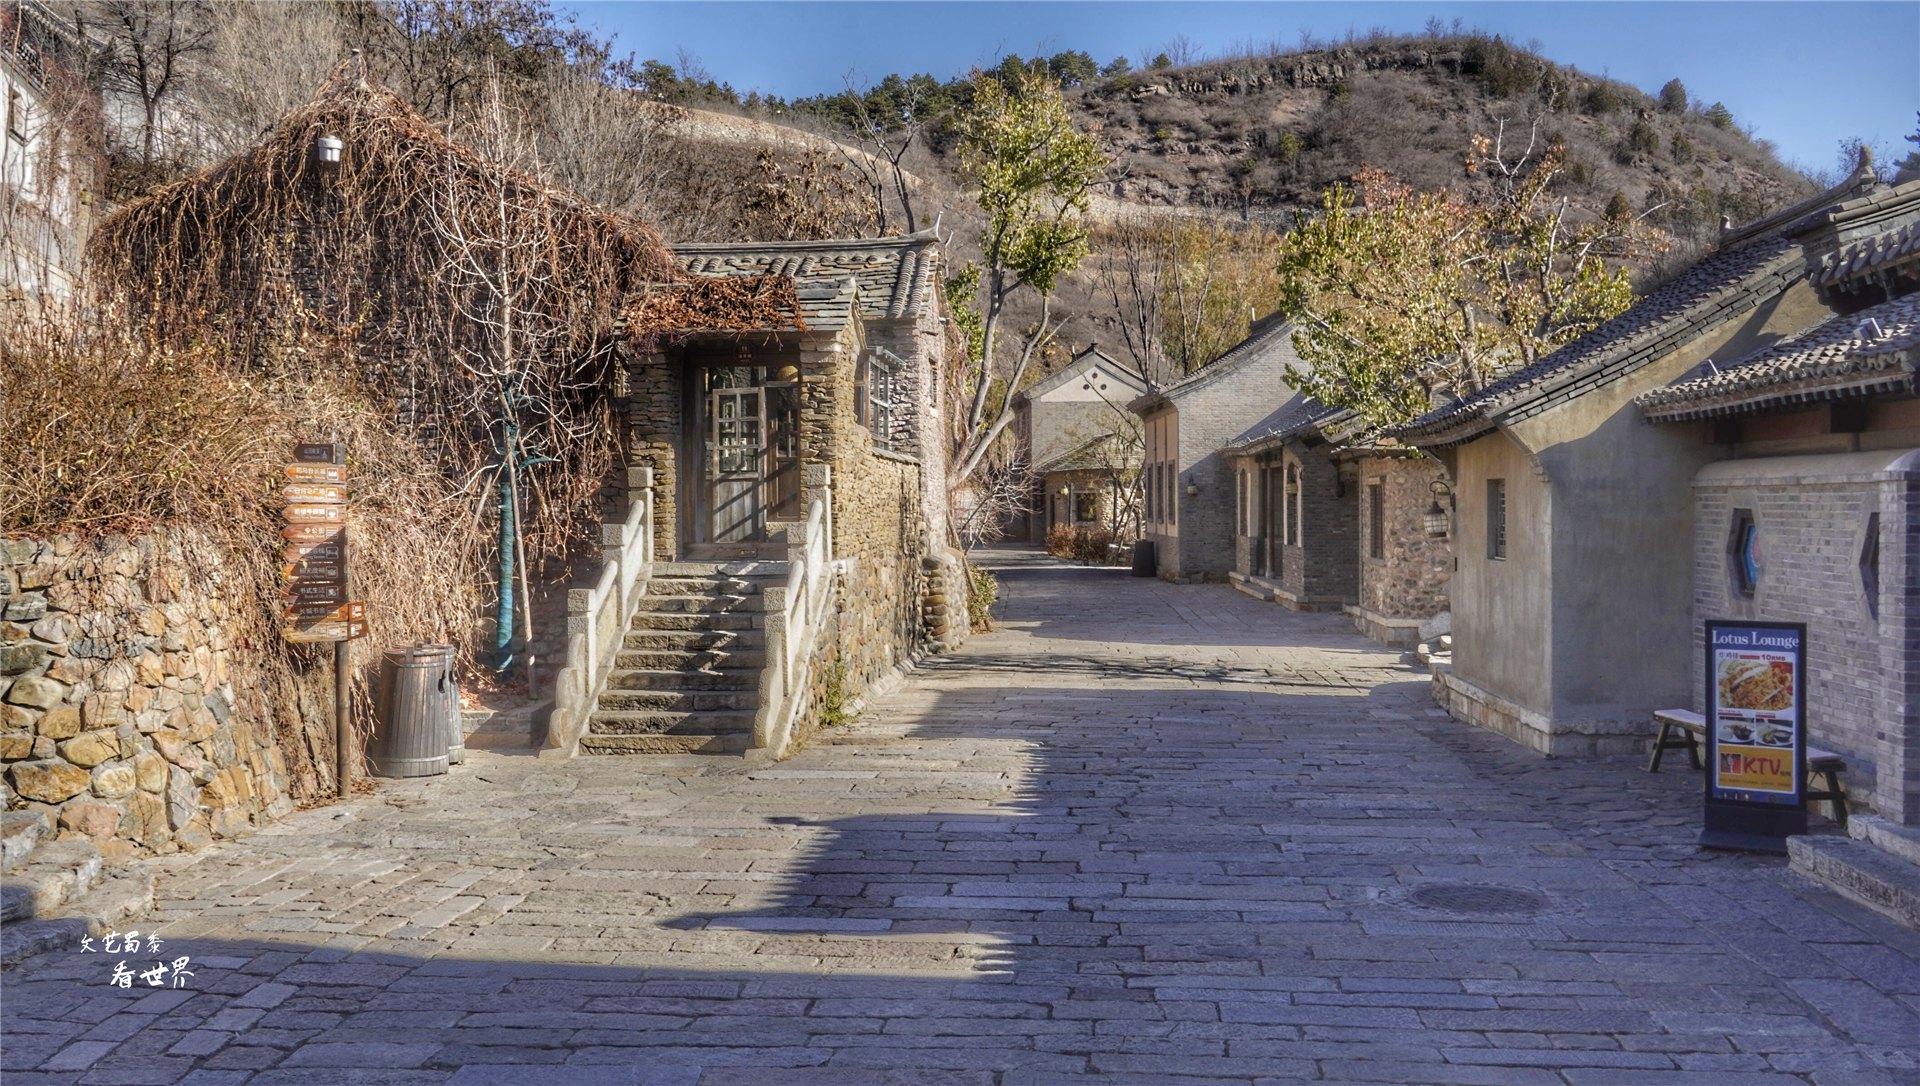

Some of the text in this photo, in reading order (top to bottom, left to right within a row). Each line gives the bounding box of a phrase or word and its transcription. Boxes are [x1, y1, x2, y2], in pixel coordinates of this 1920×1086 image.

[1712, 630, 1799, 649] Lotus Lounge
[1744, 756, 1781, 776] KTV
